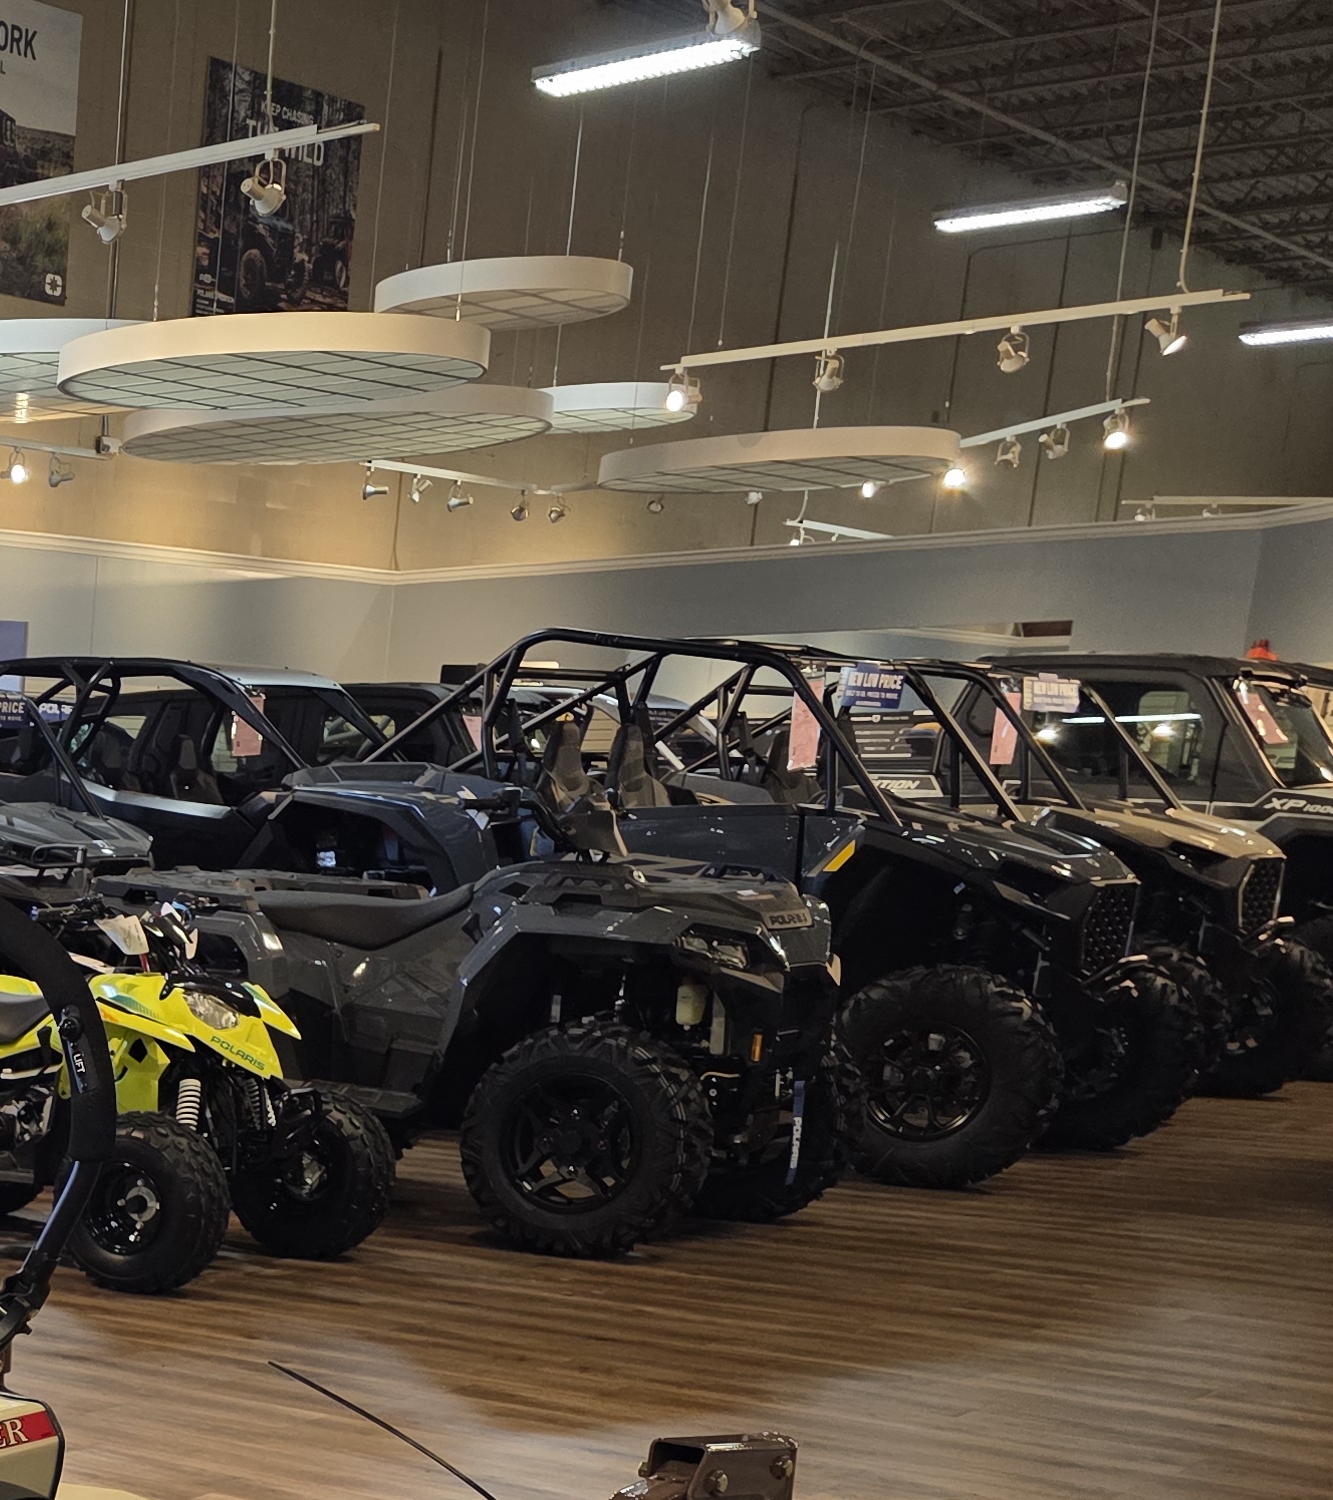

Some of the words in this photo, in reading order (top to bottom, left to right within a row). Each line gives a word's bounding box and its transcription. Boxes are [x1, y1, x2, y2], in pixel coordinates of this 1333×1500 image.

[261, 100, 281, 116] KEP
[1263, 797, 1307, 810] XP
[1302, 804, 1333, 815] 100
[210, 1035, 266, 1071] POLARIS
[73, 1053, 86, 1074] LIFT
